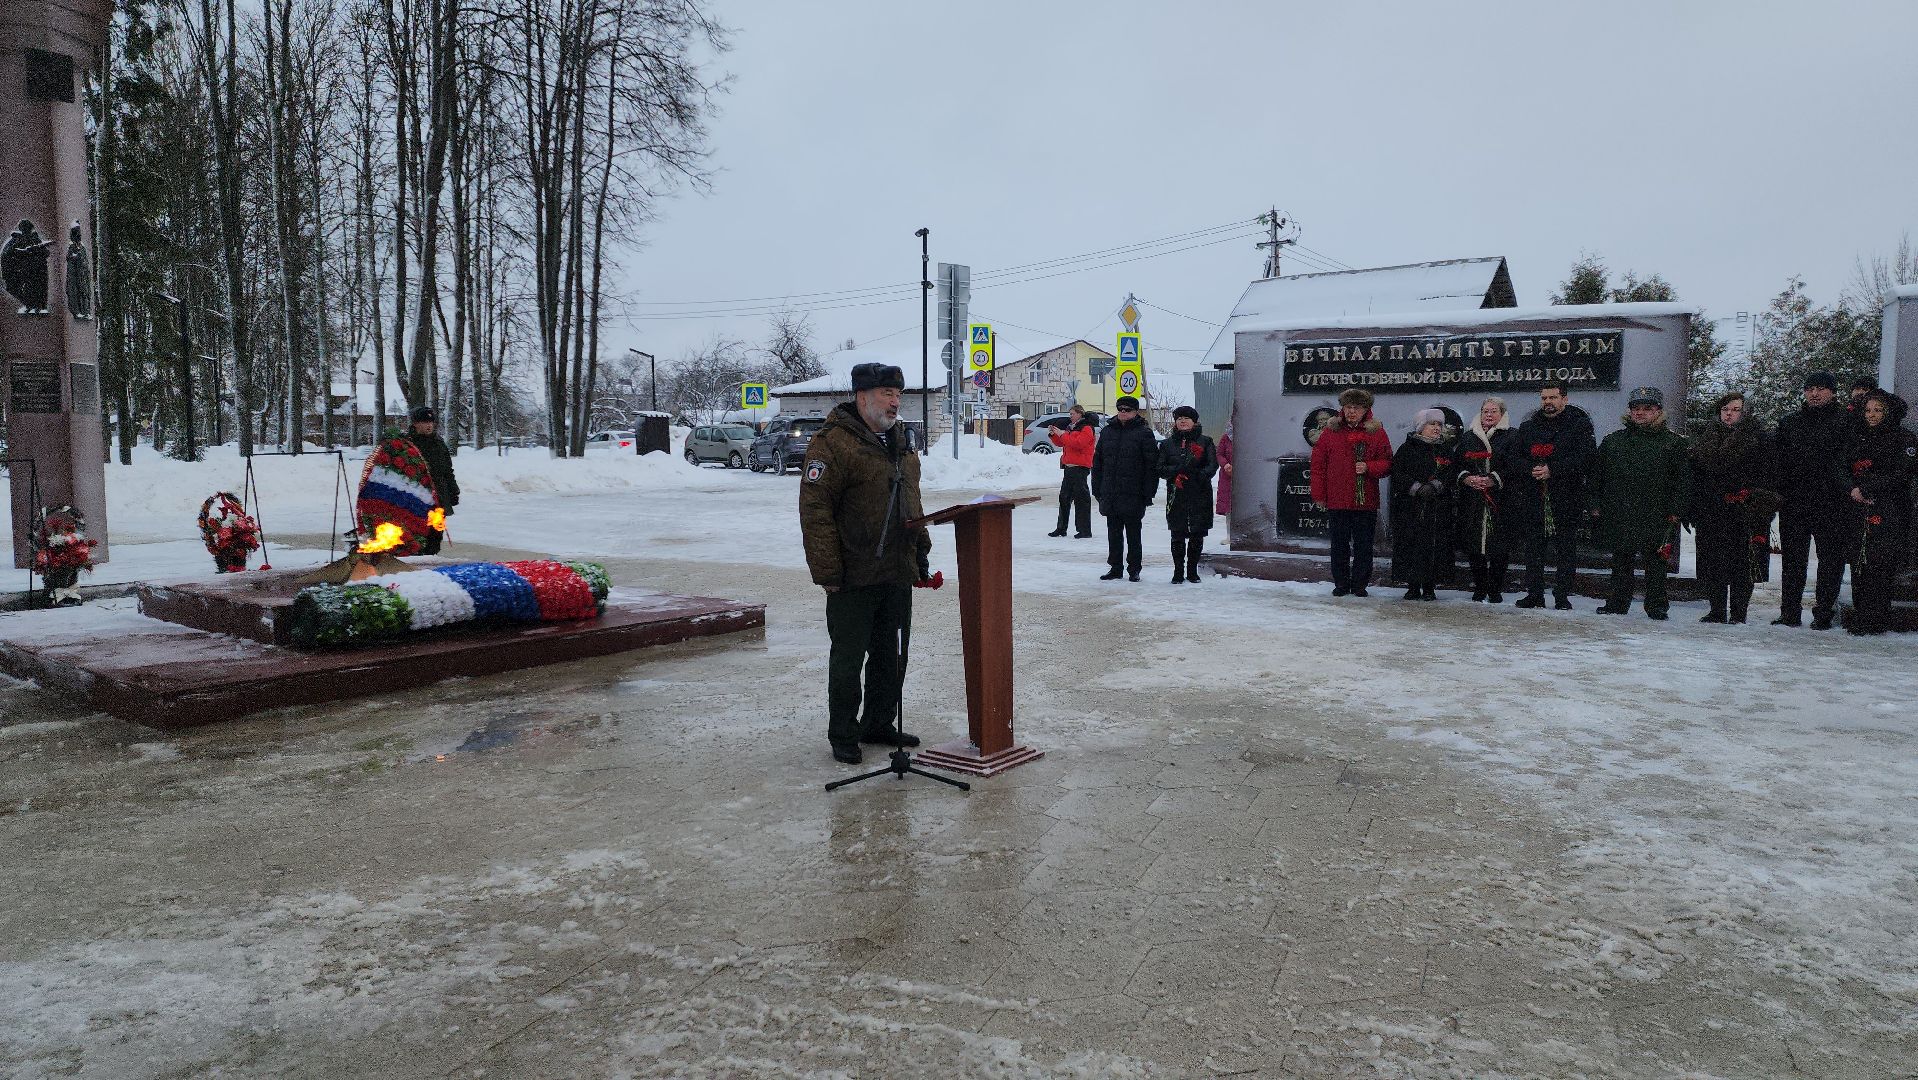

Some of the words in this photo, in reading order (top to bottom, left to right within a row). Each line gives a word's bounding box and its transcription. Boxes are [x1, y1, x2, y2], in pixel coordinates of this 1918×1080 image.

[1285, 345, 1382, 363] ВЕЧНАЯ
[1389, 341, 1495, 360] ПАМЯТЬ
[1503, 338, 1616, 357] ГЕРОЯМ
[1123, 377, 1134, 388] 20
[1298, 368, 1435, 386] ОТЕЧЕСТВЕННОЙ
[1438, 366, 1503, 383] ВОЙНЫ
[1507, 368, 1543, 382] 1812
[1545, 367, 1597, 383] ГОДА
